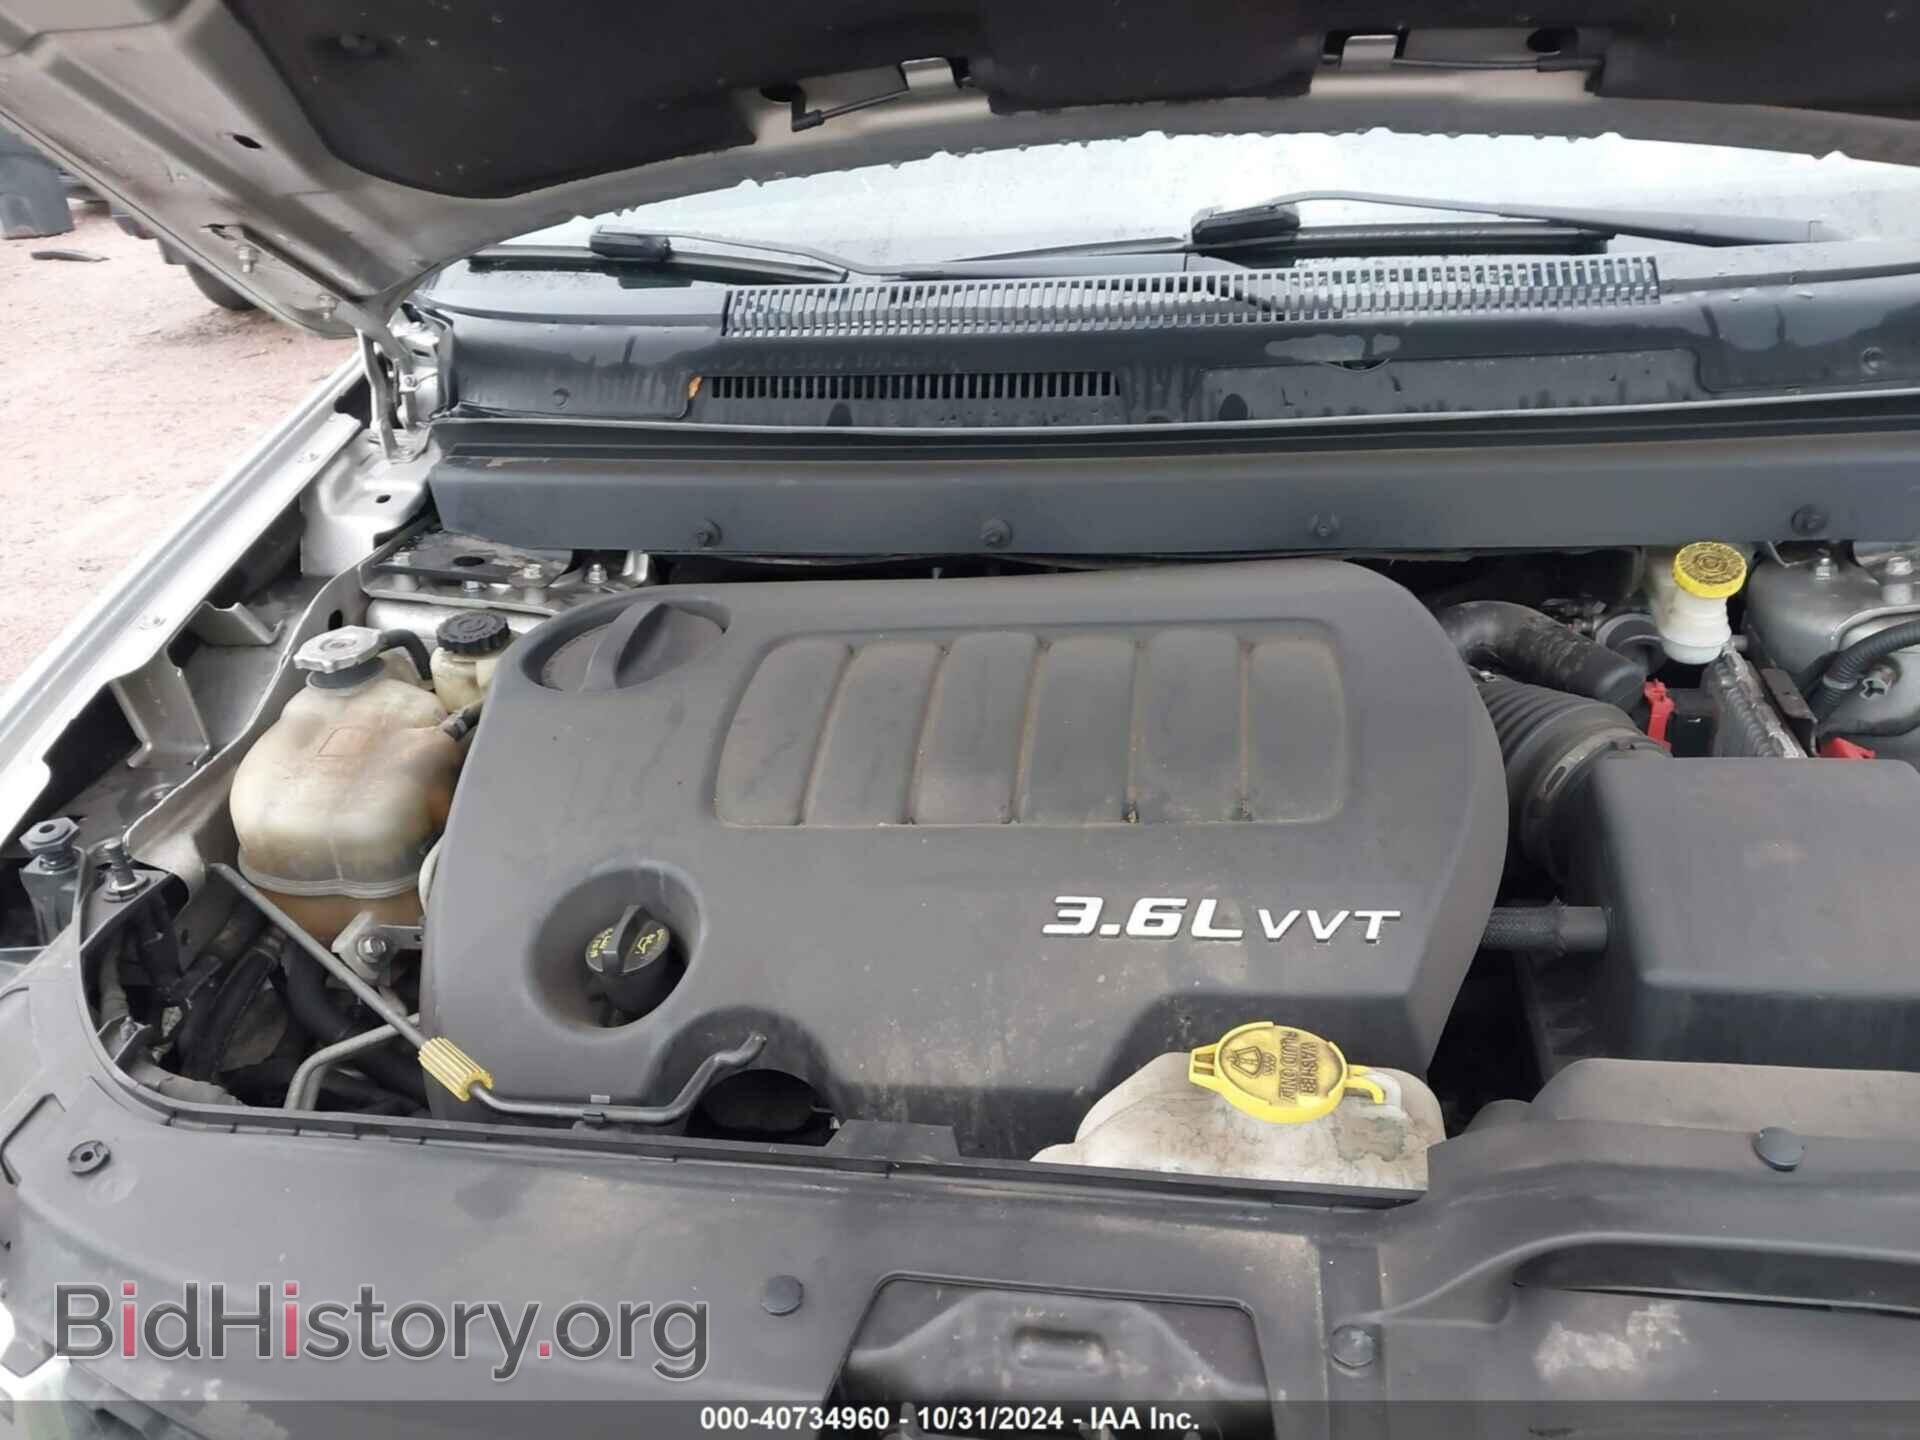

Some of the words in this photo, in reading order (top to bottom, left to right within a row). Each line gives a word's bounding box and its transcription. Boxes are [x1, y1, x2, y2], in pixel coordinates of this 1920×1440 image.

[1042, 896, 1243, 940] 3.6L
[1258, 909, 1401, 943] VVT
[1279, 1068, 1298, 1104] ONLY
[1300, 1042, 1318, 1096] WASHER
